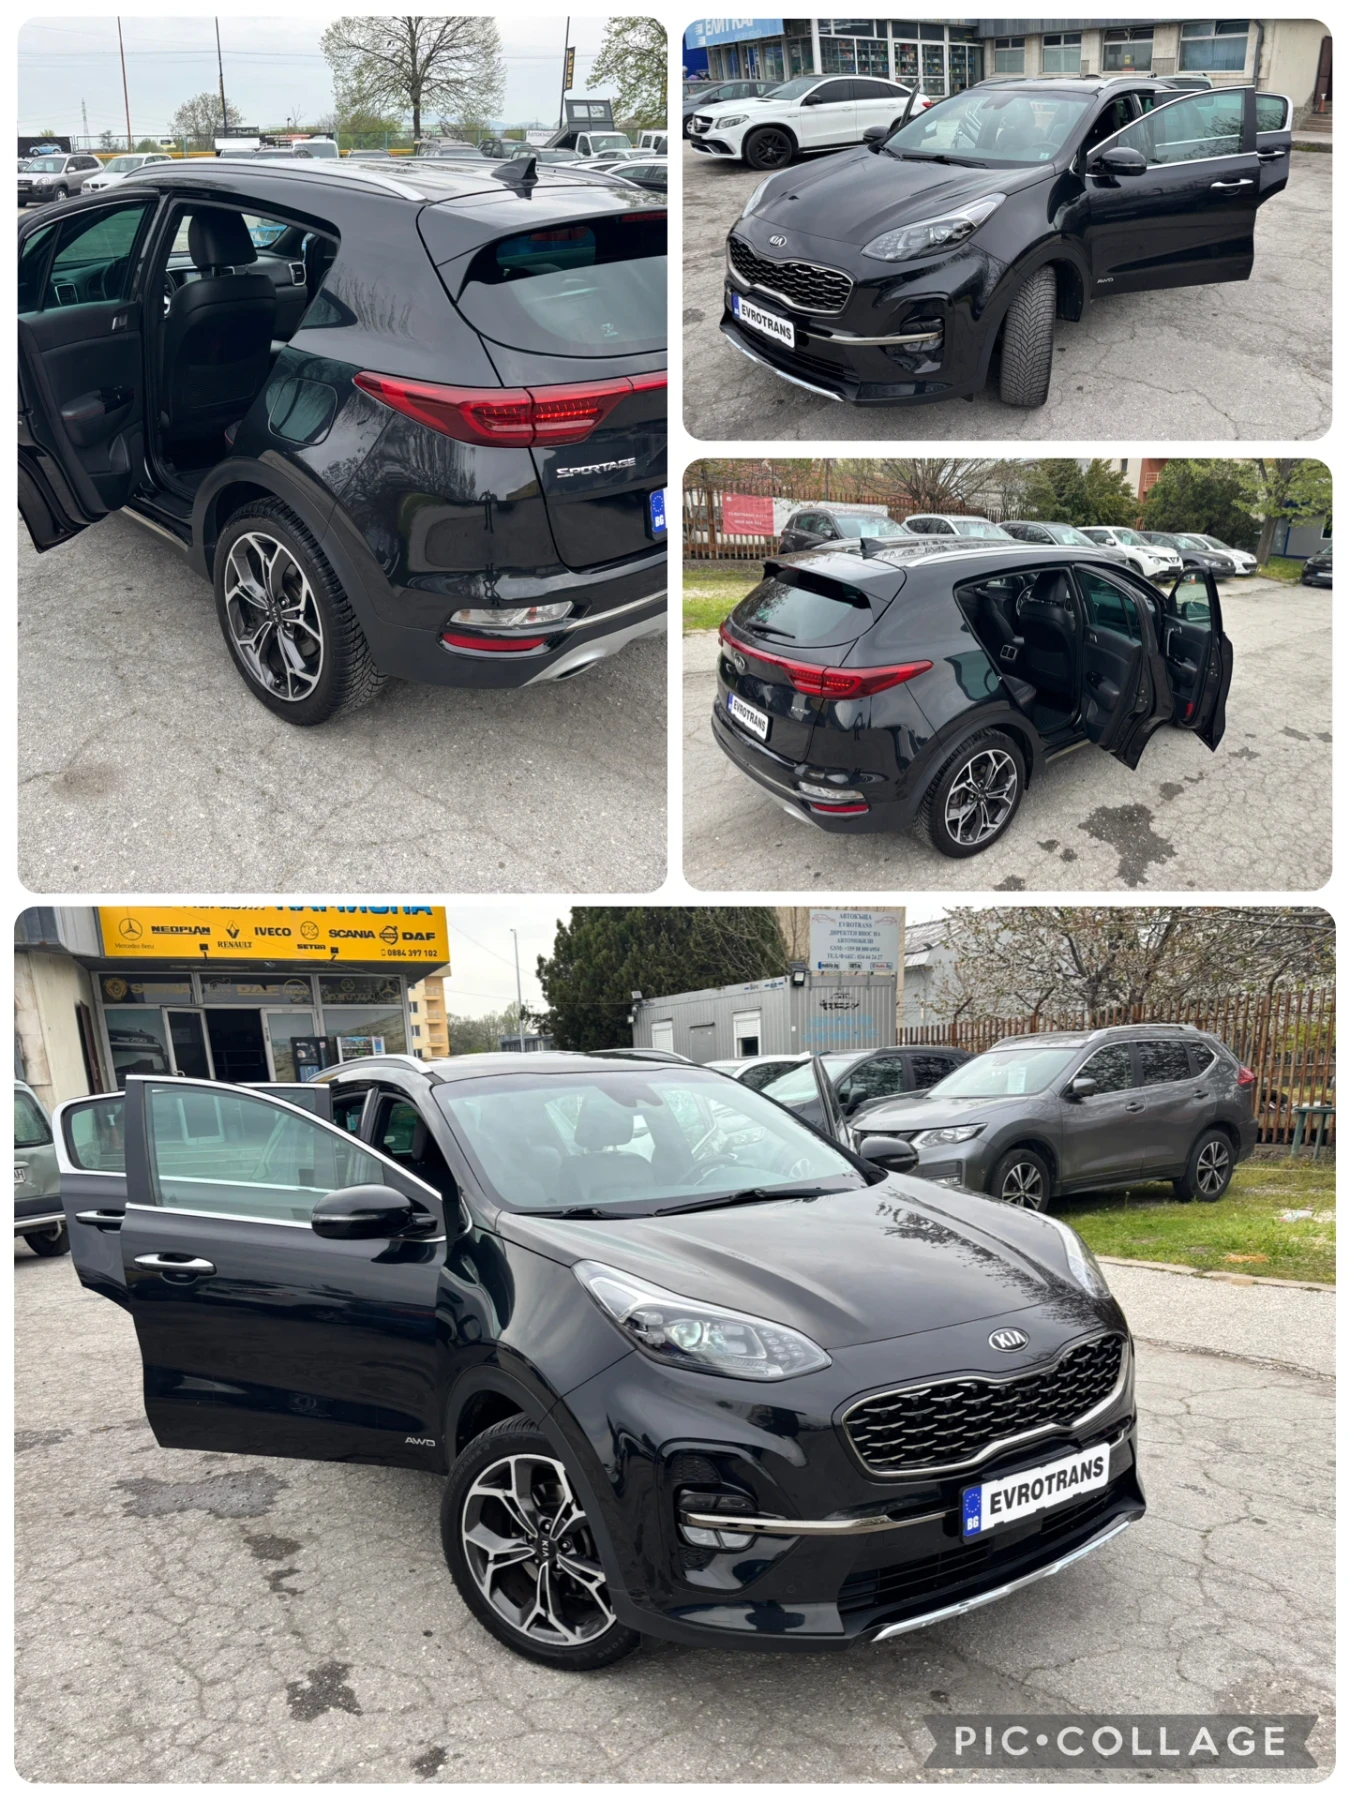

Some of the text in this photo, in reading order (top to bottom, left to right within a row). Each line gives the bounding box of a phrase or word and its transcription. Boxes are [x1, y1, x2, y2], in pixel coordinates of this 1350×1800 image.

[741, 304, 792, 340] EVROTRANS
[556, 457, 636, 479] SPORTAGE
[655, 514, 665, 528] BG
[733, 699, 766, 732] EVROTRANS
[151, 925, 211, 935] NEOPLAN
[254, 926, 292, 937] IVECO
[328, 929, 376, 939] SCANIA
[402, 932, 436, 941] DAF
[114, 942, 155, 950] Mercedes-Benz
[217, 941, 253, 949] RENAULT
[387, 949, 407, 957] 0884
[408, 949, 422, 957] 397
[995, 1330, 1026, 1348] KIA
[405, 1437, 436, 1447] AWD
[990, 1456, 1104, 1515] EVROTRANS
[967, 1516, 979, 1531] BG
[541, 1539, 549, 1558] KIA
